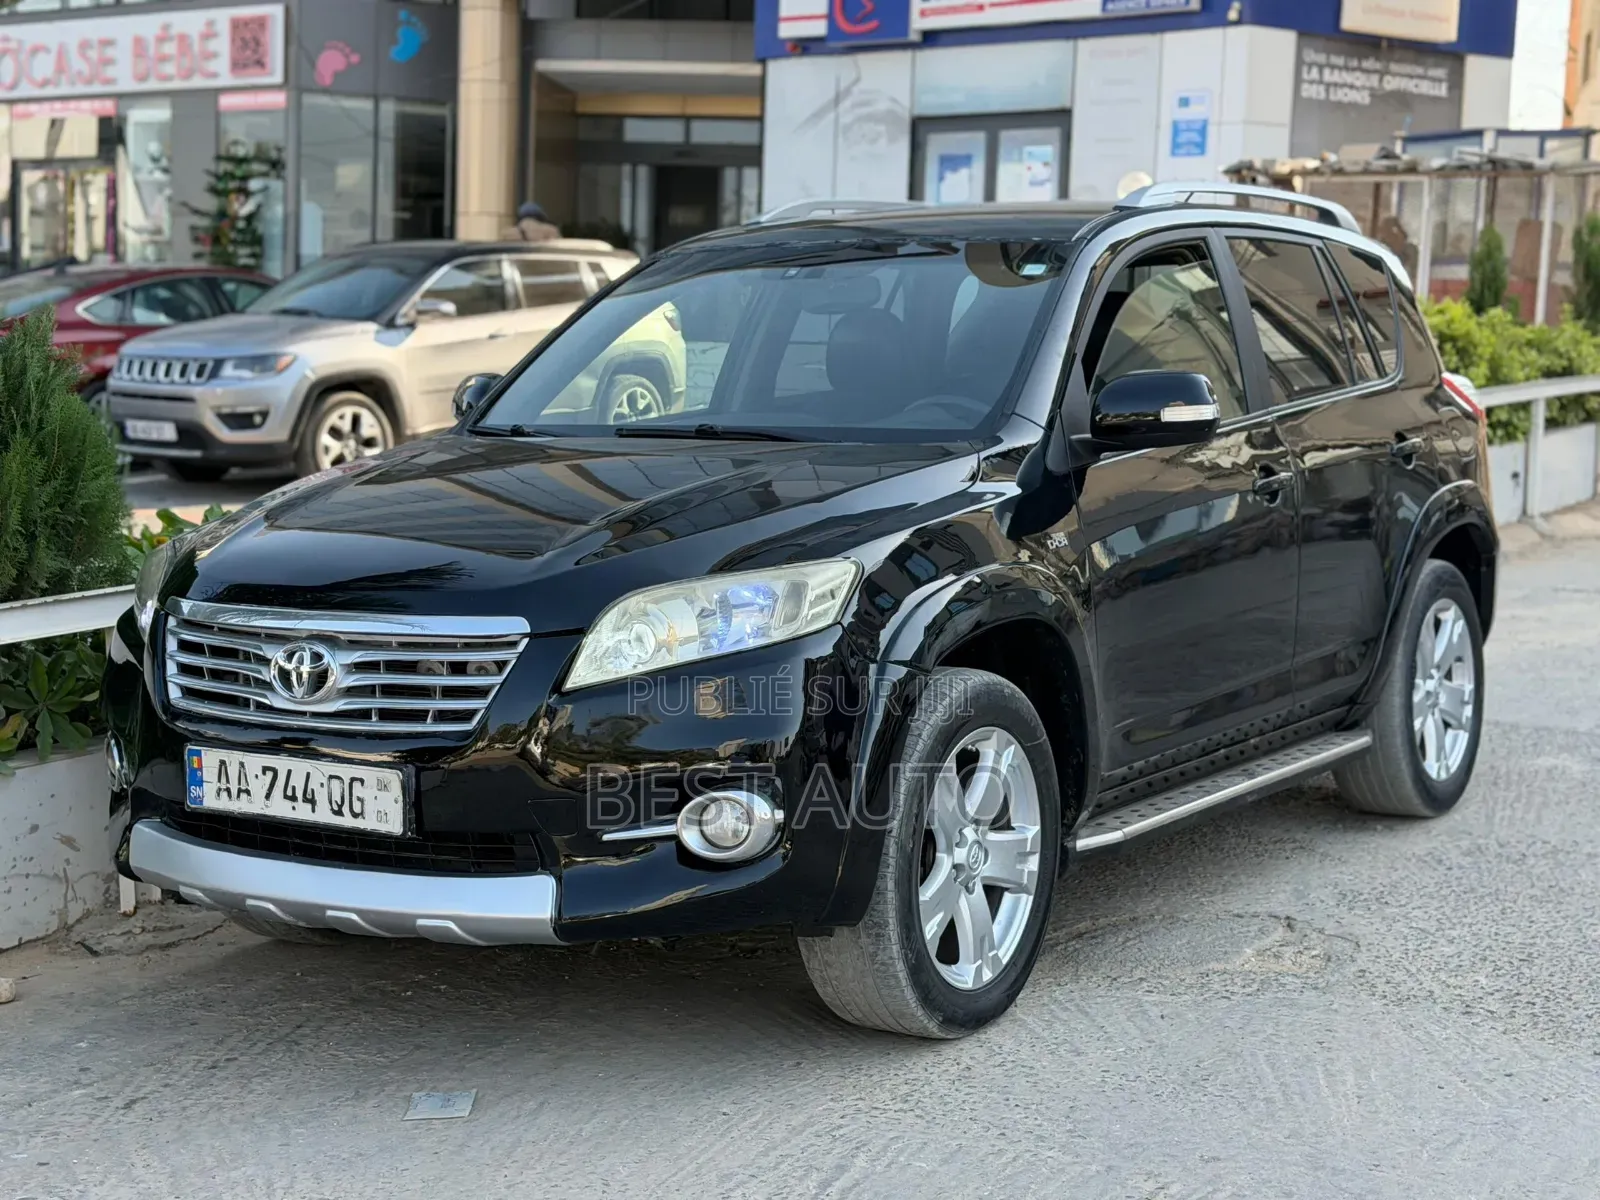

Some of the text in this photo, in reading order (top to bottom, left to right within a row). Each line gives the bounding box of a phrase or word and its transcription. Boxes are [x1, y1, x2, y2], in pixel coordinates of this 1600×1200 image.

[132, 18, 220, 83] BÉBÉ
[1301, 64, 1320, 81] LA
[1322, 66, 1380, 89] BANQUE
[190, 785, 204, 799] SN
